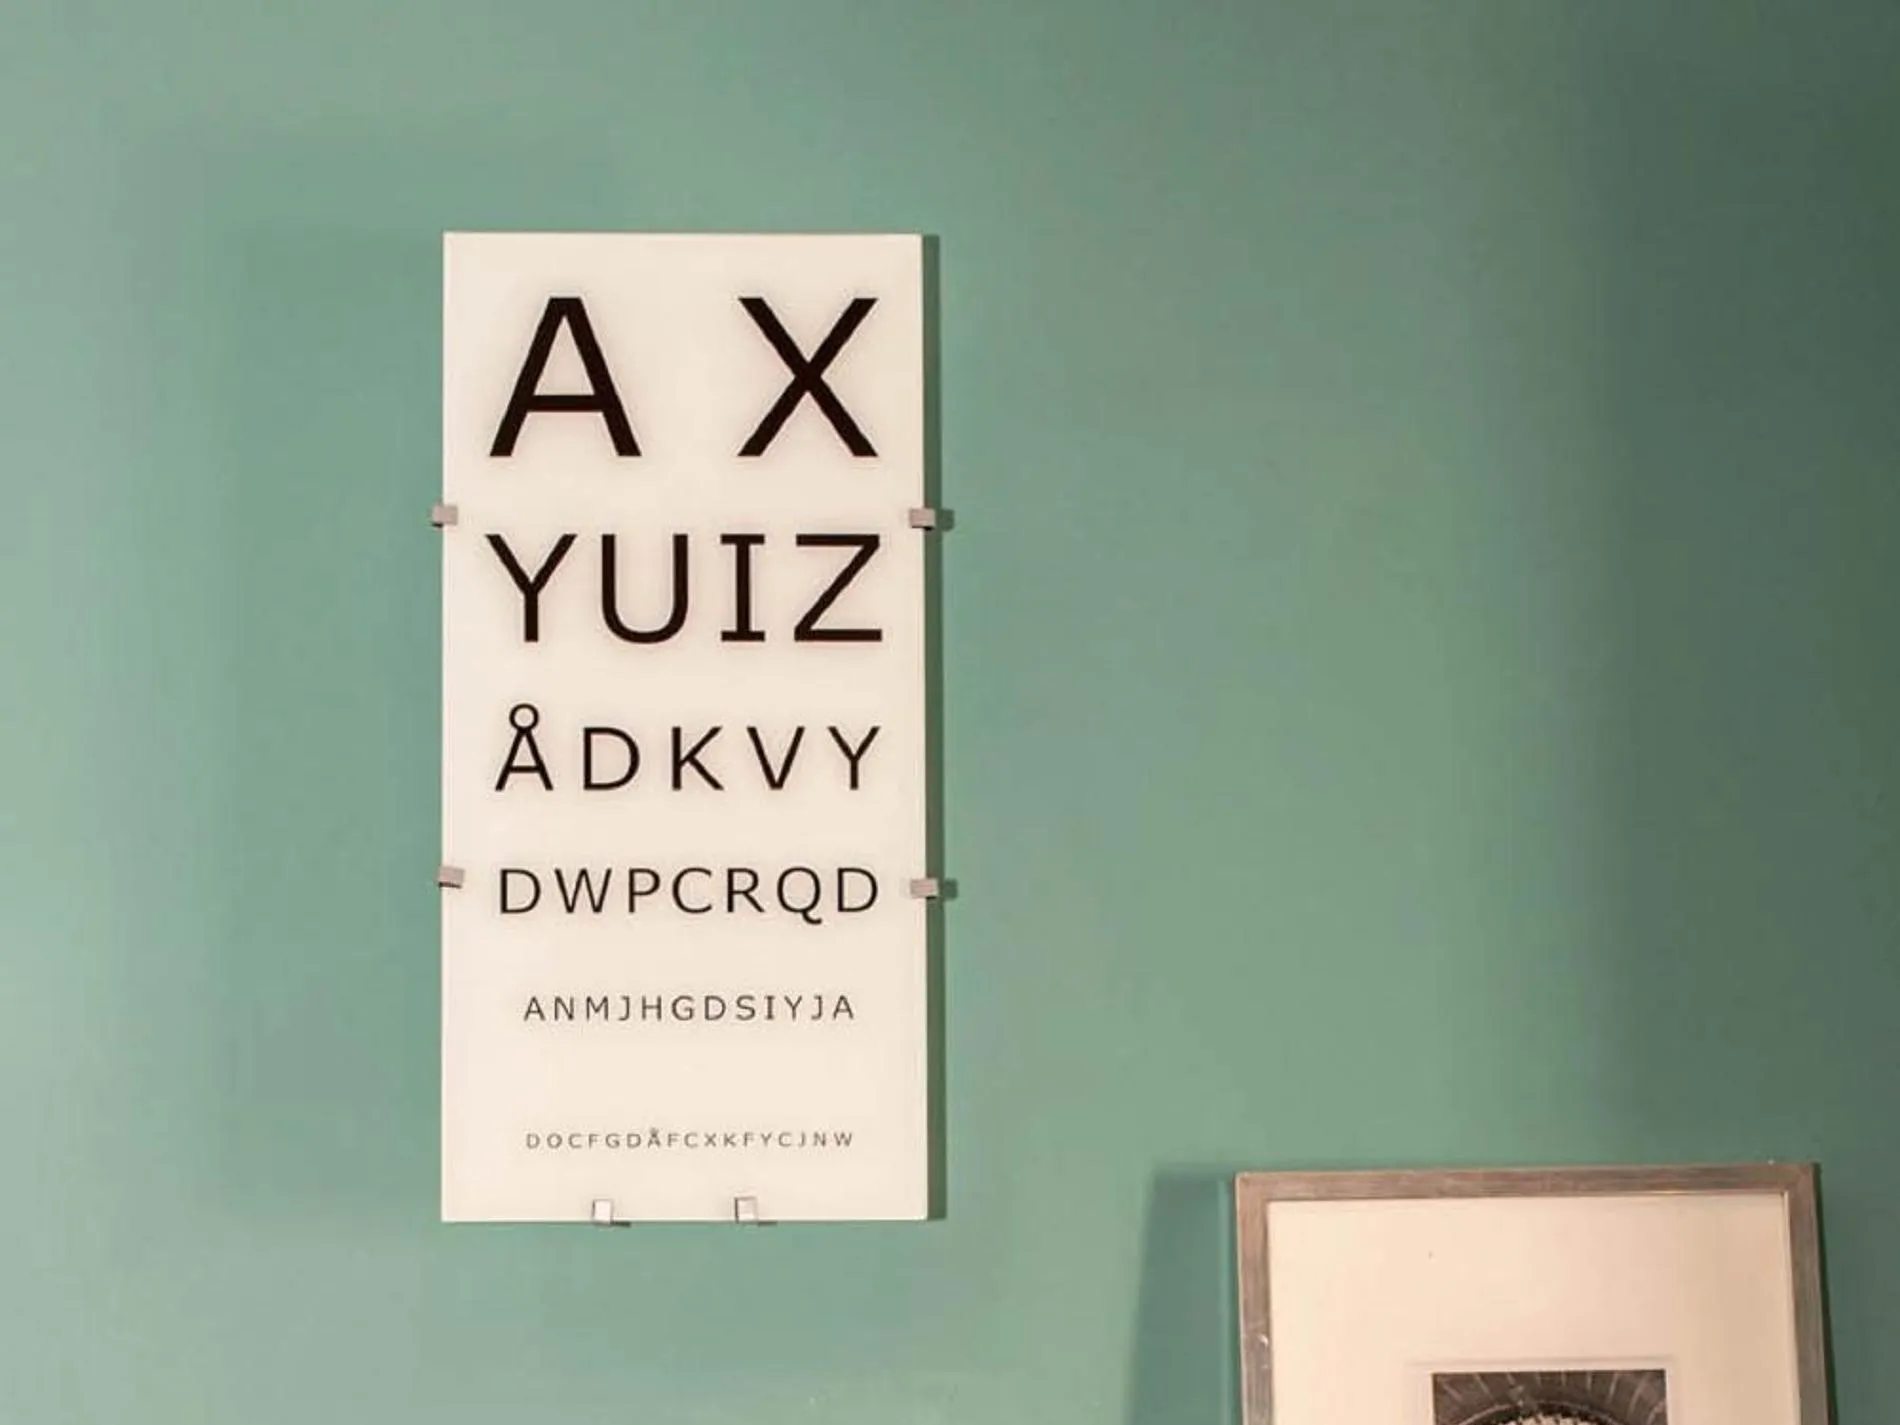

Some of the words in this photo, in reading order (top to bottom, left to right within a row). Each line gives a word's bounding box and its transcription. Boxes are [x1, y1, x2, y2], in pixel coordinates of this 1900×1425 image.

[489, 296, 642, 458] A
[736, 296, 880, 458] X
[485, 533, 884, 645] YUIZ
[494, 703, 882, 792] ÅDKVY
[498, 866, 880, 926] DWPCRQD
[522, 993, 856, 1023] ANMJHGDSIYJA
